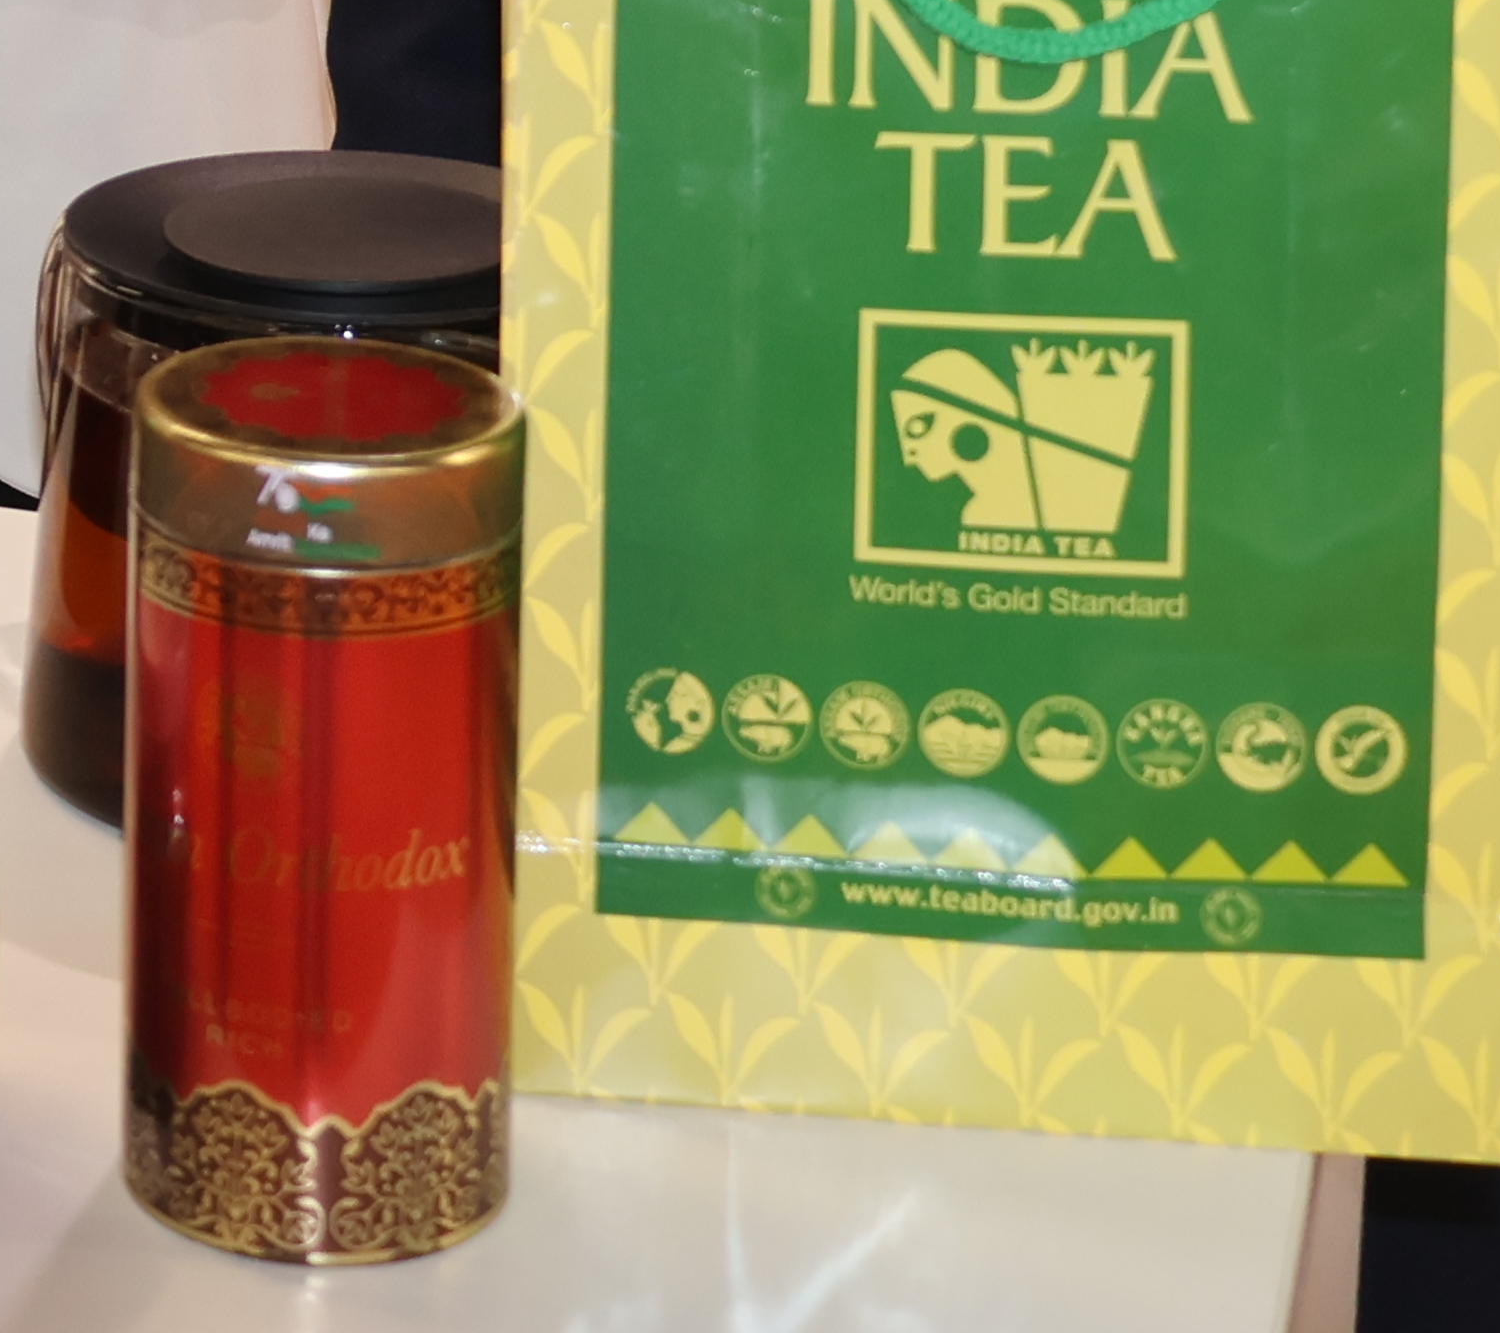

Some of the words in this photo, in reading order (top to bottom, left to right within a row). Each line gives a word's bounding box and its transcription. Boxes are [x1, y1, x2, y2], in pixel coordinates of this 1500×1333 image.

[874, 130, 1178, 262] TEA
[957, 529, 1045, 556] INDIA
[1053, 535, 1117, 559] TEA
[848, 574, 962, 610] World's
[967, 581, 1042, 615] Gold
[1049, 586, 1189, 619] Standard
[229, 828, 472, 892] Orthodox
[840, 880, 1180, 927] www.teaboard.gov.in
